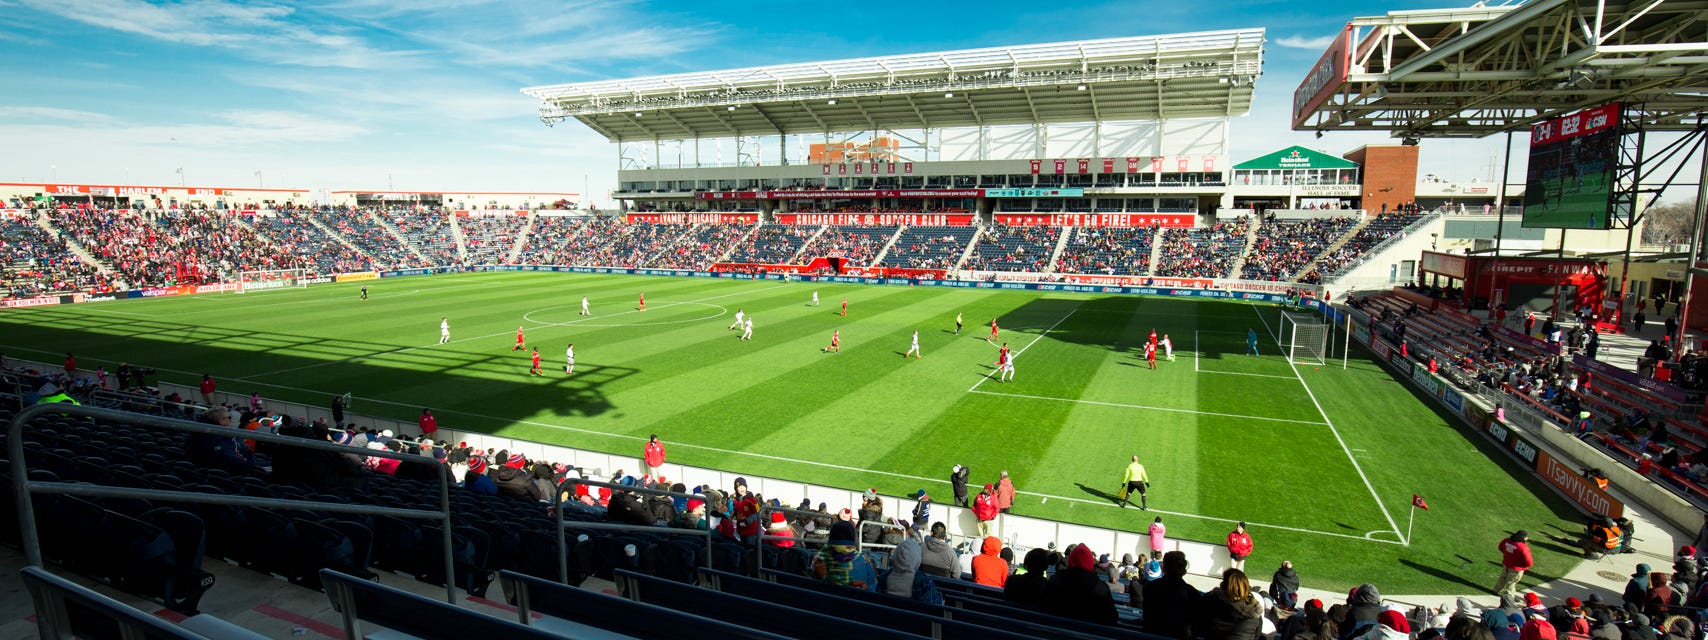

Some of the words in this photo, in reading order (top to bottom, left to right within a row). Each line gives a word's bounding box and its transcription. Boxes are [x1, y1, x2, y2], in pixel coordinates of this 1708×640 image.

[120, 187, 161, 195] HARLEM
[796, 215, 833, 225] CHICAGO
[838, 215, 859, 225] FIRE
[922, 215, 946, 225] CLUB
[1051, 214, 1080, 226] LET'S
[1084, 215, 1097, 226] GO
[1102, 215, 1131, 226] FIRE!
[244, 280, 283, 289] Heineken
[142, 289, 167, 297] valspar
[1413, 363, 1439, 396] Heineken
[1489, 421, 1508, 442] ECHO
[1515, 439, 1536, 463] ECHO
[1547, 456, 1610, 516] ITsavvy.com
